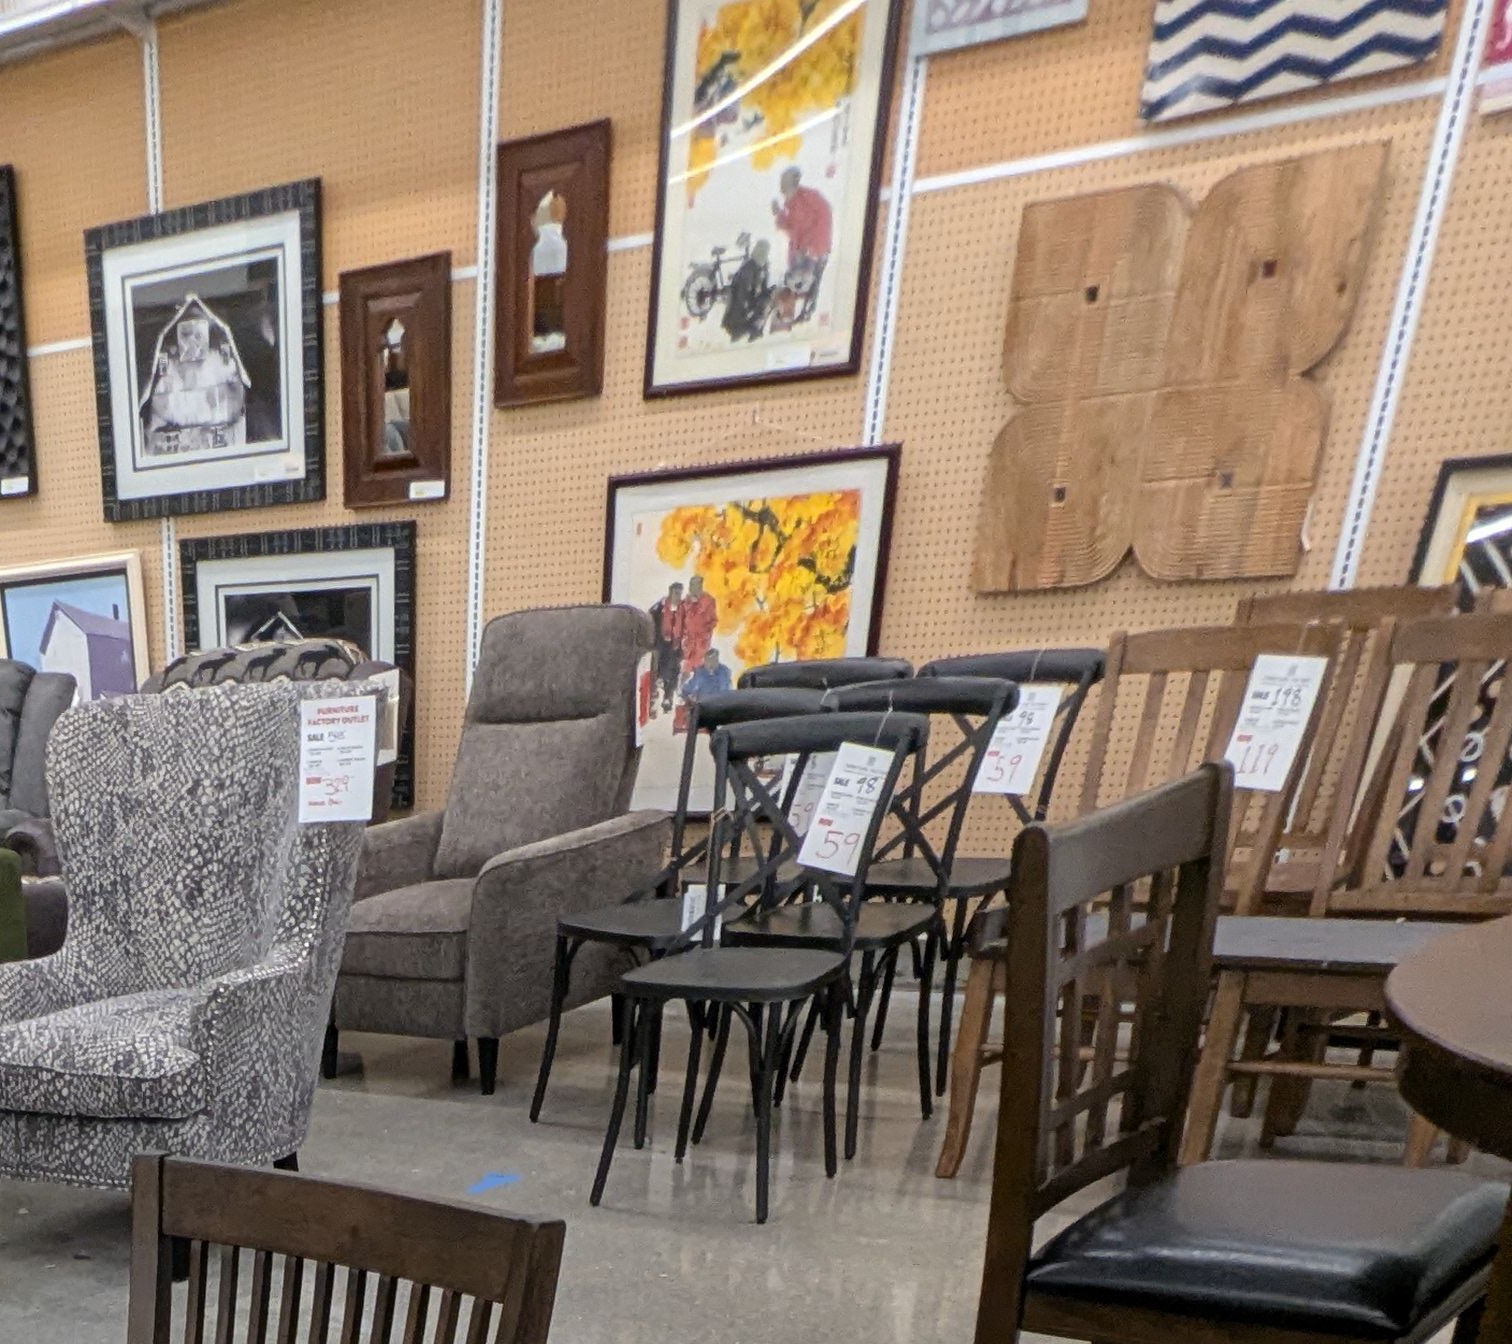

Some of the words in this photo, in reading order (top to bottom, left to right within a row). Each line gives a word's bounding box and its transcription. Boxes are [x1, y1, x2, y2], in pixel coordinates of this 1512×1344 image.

[1271, 687, 1302, 706] 198
[308, 717, 340, 726] FACTORY
[342, 715, 370, 724] OUTLET
[857, 776, 878, 794] 98
[816, 831, 861, 866] 59
